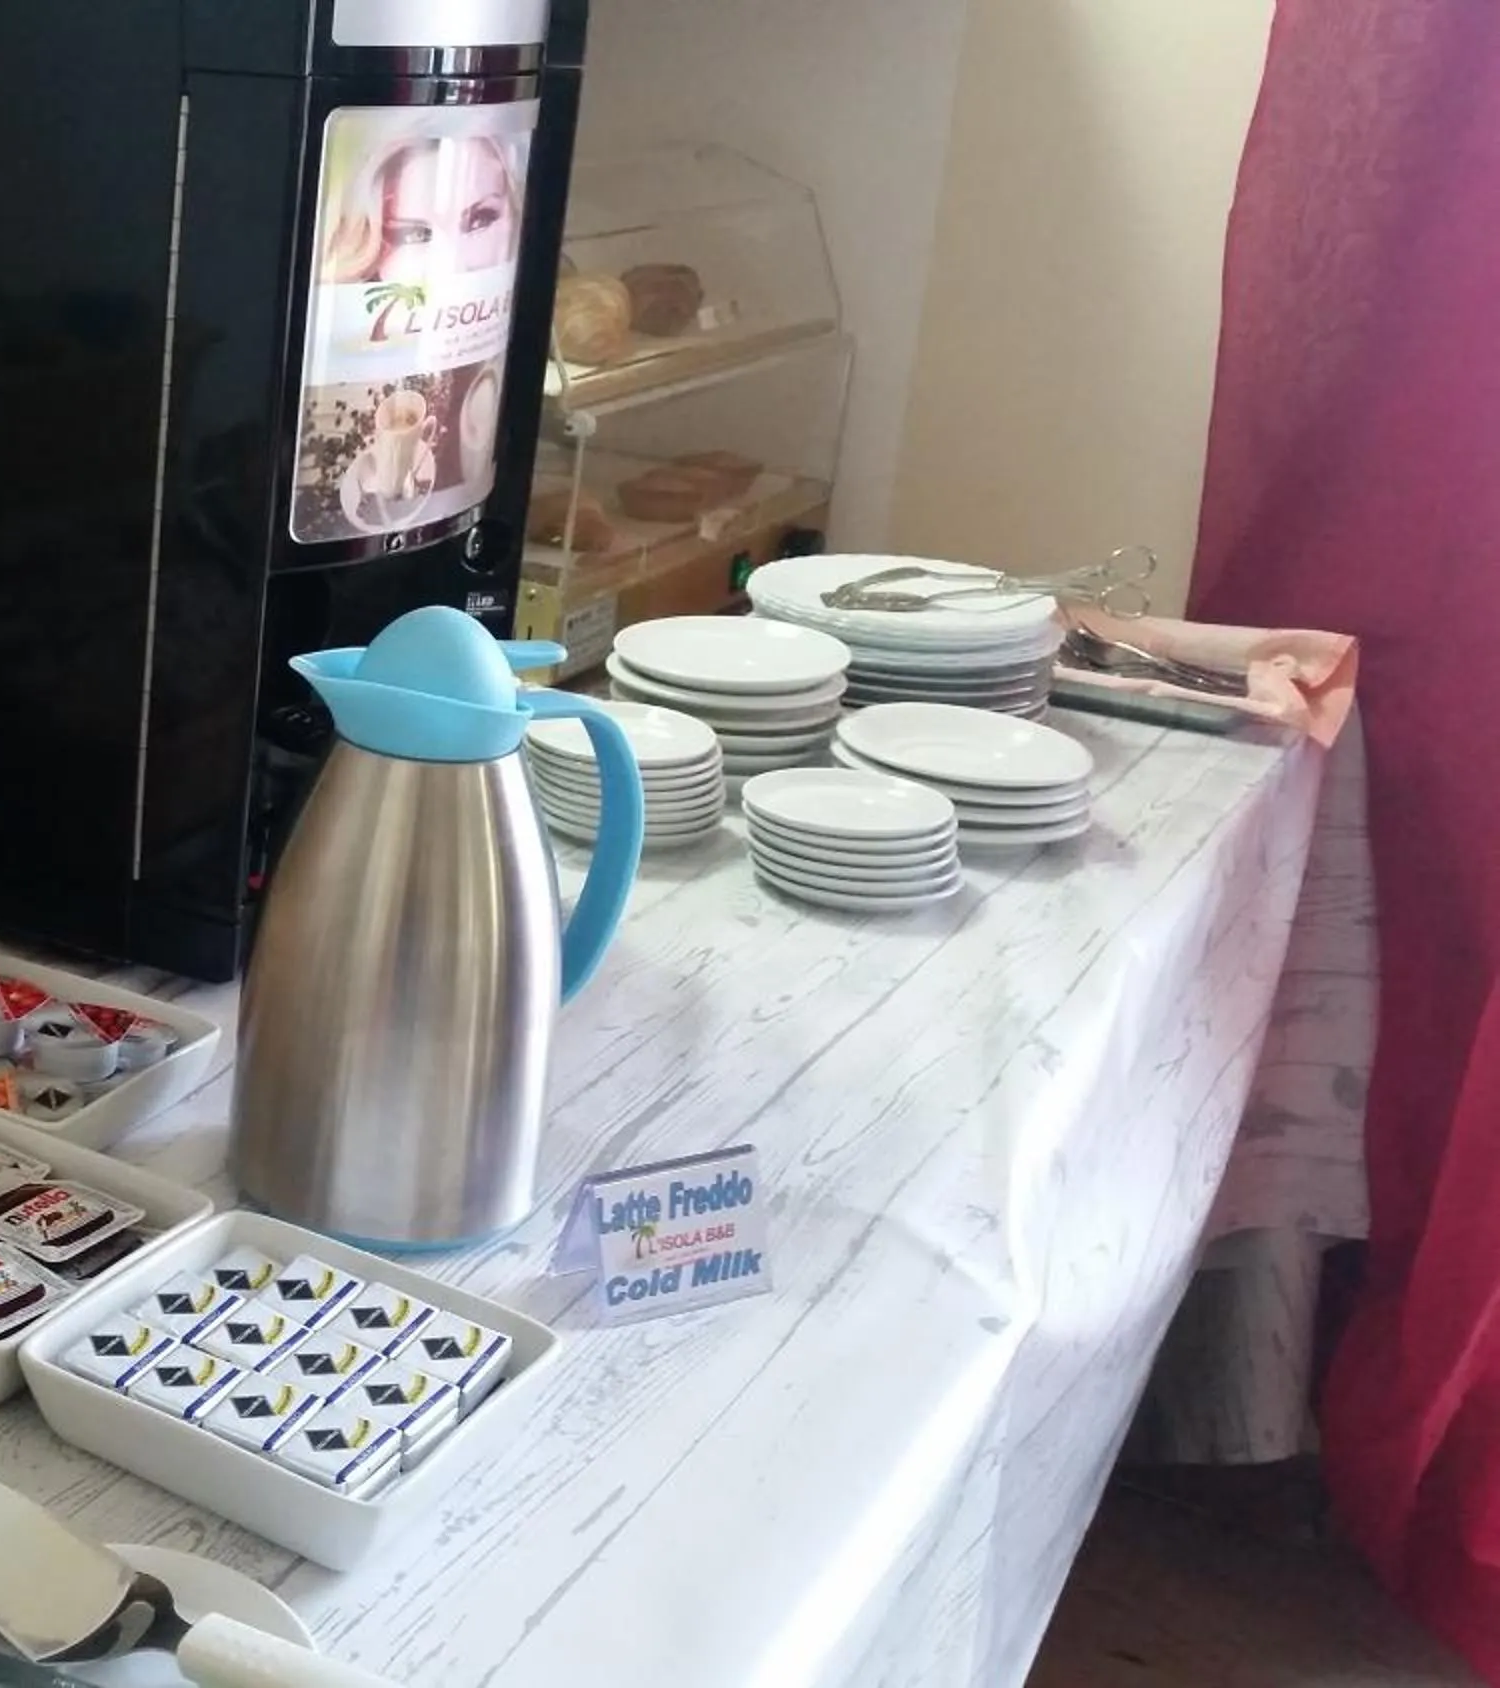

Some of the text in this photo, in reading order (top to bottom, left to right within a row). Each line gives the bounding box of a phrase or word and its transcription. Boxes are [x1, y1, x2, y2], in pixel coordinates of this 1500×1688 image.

[5, 1188, 72, 1227] nutella
[596, 1169, 754, 1235] Latte Freddo
[705, 1222, 736, 1244] B&B
[605, 1263, 683, 1307] Cold
[691, 1247, 763, 1288] Milk
